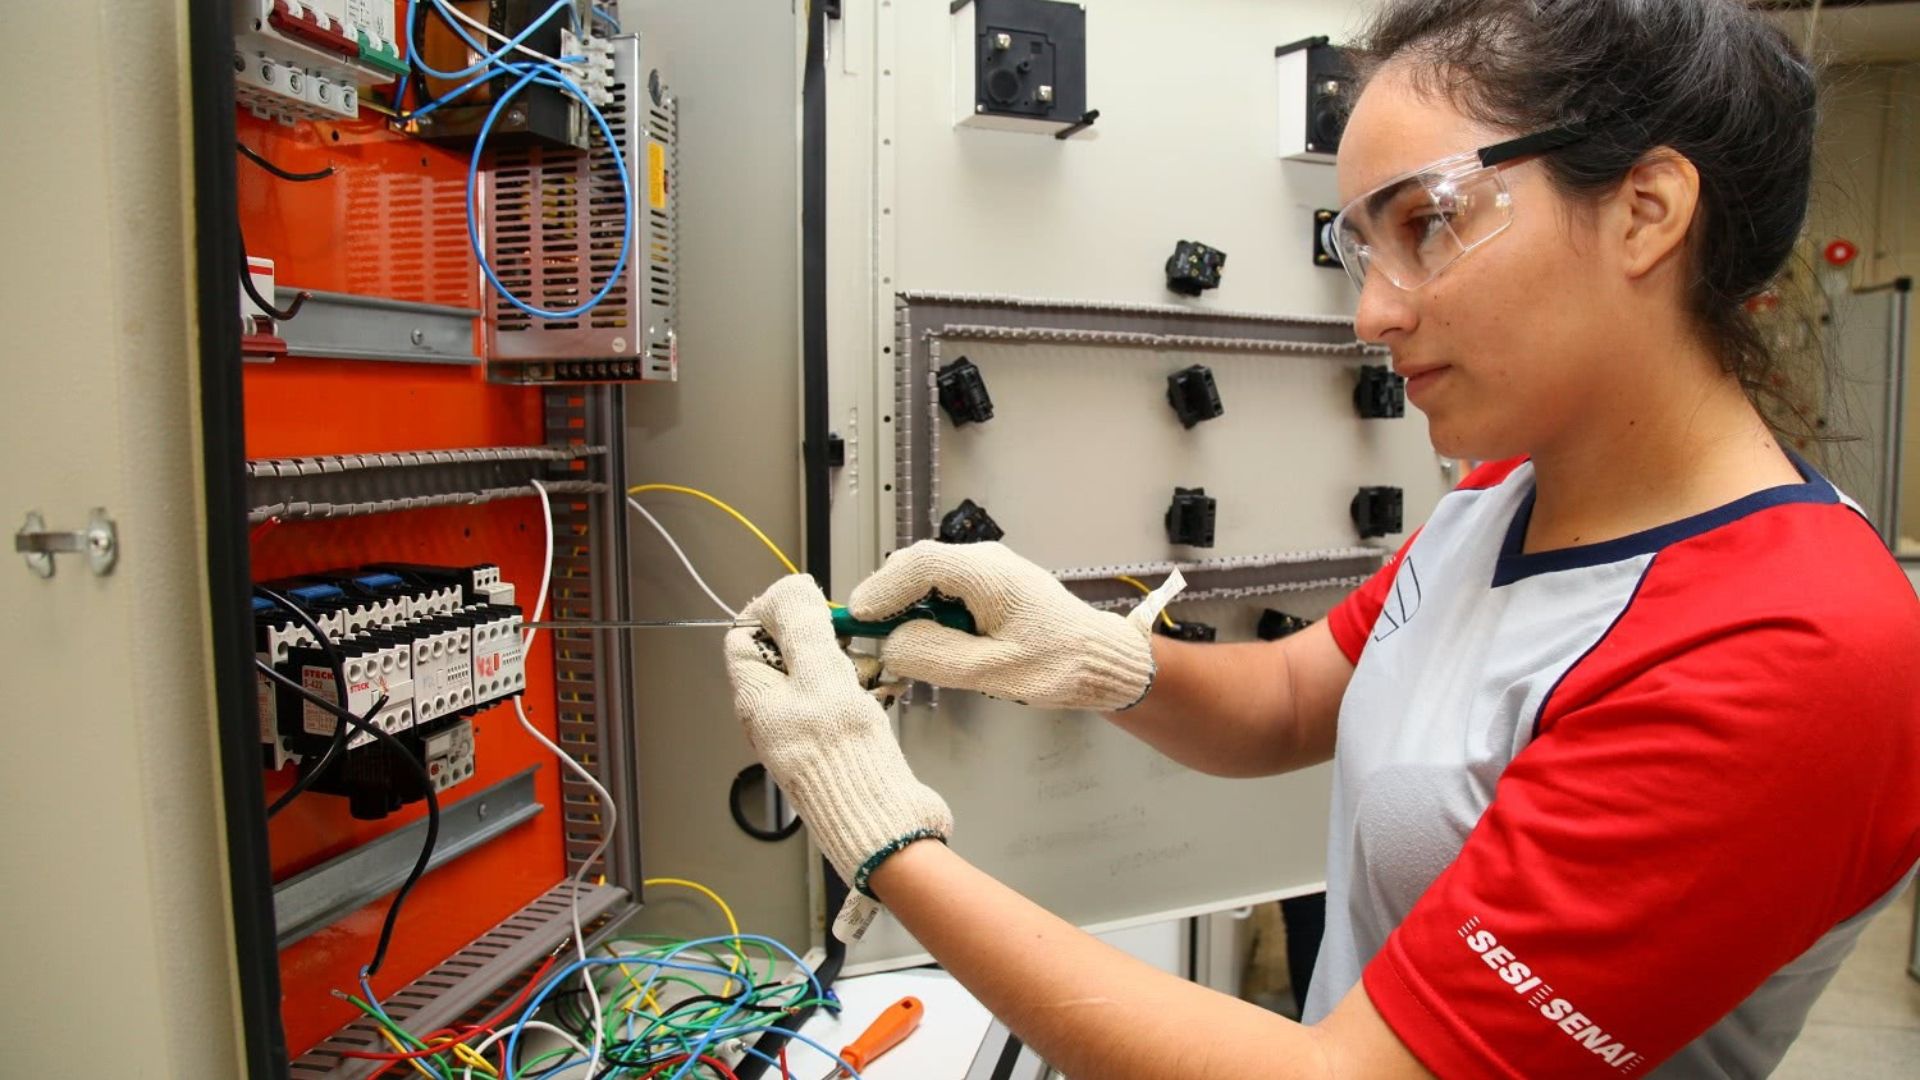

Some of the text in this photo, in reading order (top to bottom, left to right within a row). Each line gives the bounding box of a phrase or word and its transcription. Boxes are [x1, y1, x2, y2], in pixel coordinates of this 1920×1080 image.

[303, 669, 334, 680] STECK
[350, 682, 370, 693] STECK
[1466, 930, 1636, 1068] SESI SENAI
